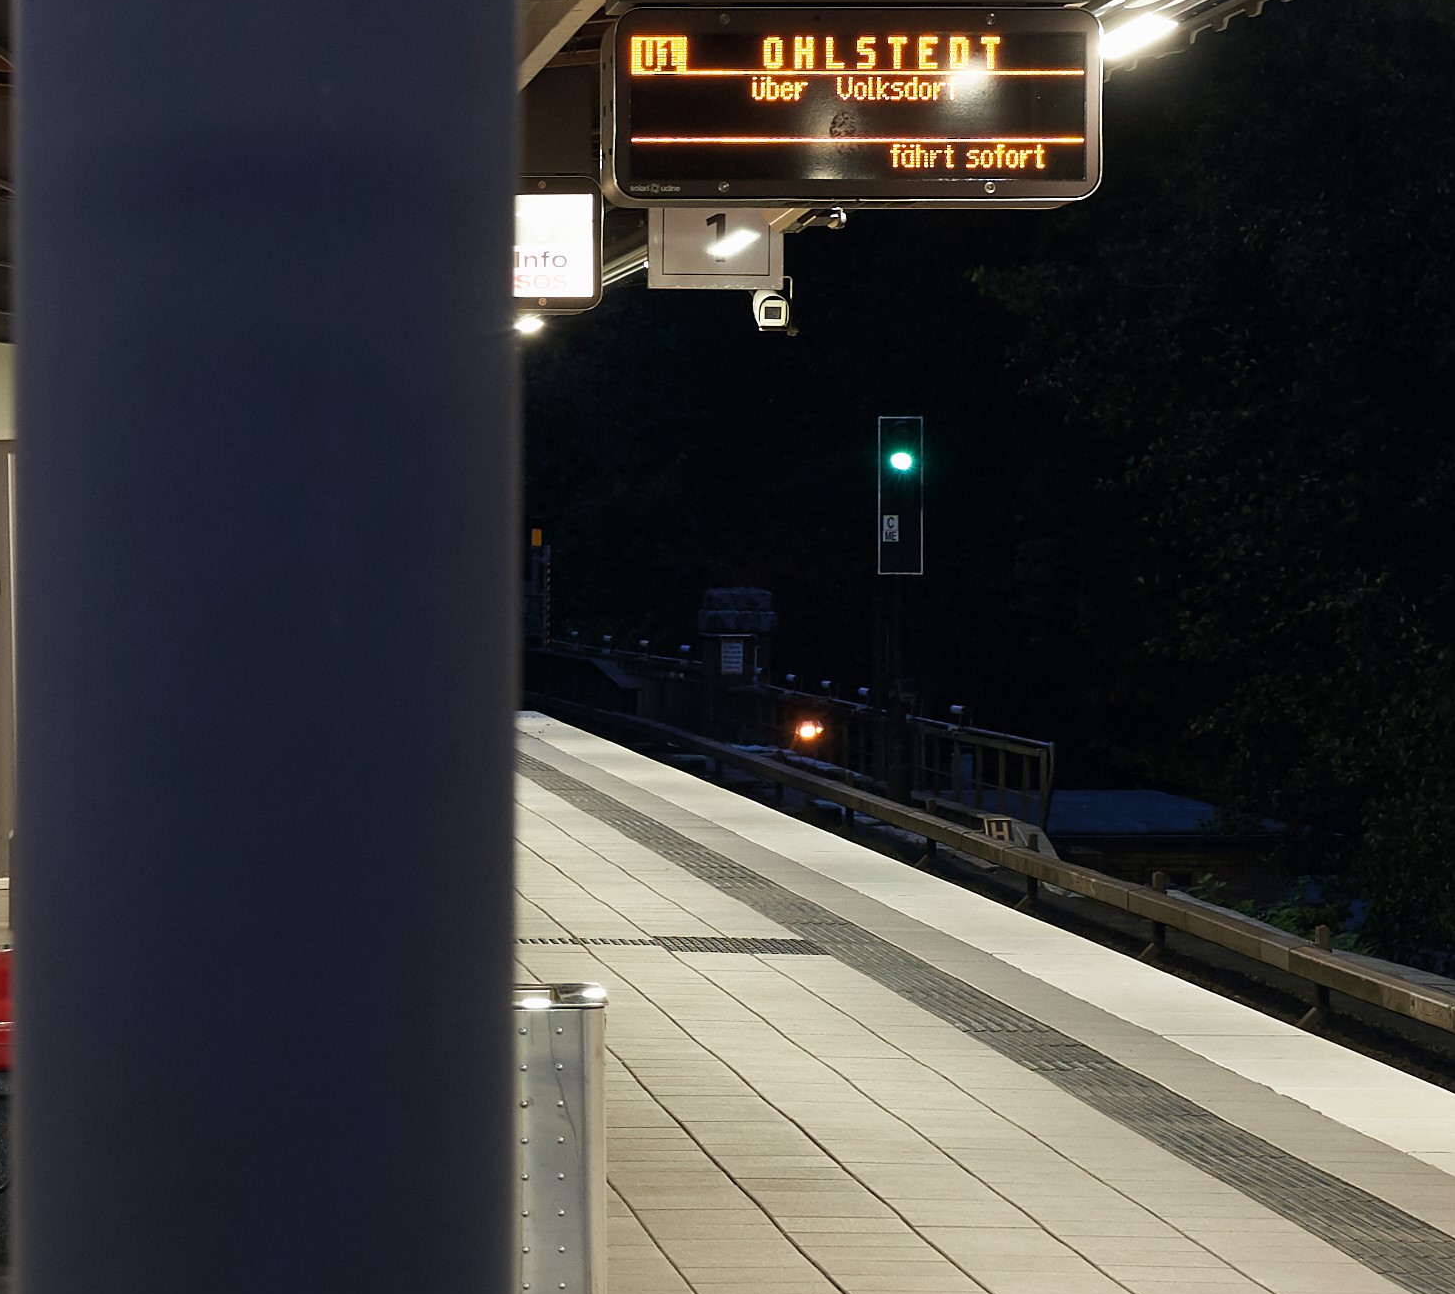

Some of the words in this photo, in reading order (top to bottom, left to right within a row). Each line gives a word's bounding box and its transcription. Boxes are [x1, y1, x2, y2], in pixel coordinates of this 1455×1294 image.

[639, 38, 680, 72] U1
[762, 36, 1001, 70] OHLSTEDT
[750, 76, 808, 101] über
[889, 143, 955, 169] fährt
[965, 143, 1046, 169] sofort
[514, 251, 568, 269] Info
[887, 516, 895, 529] C
